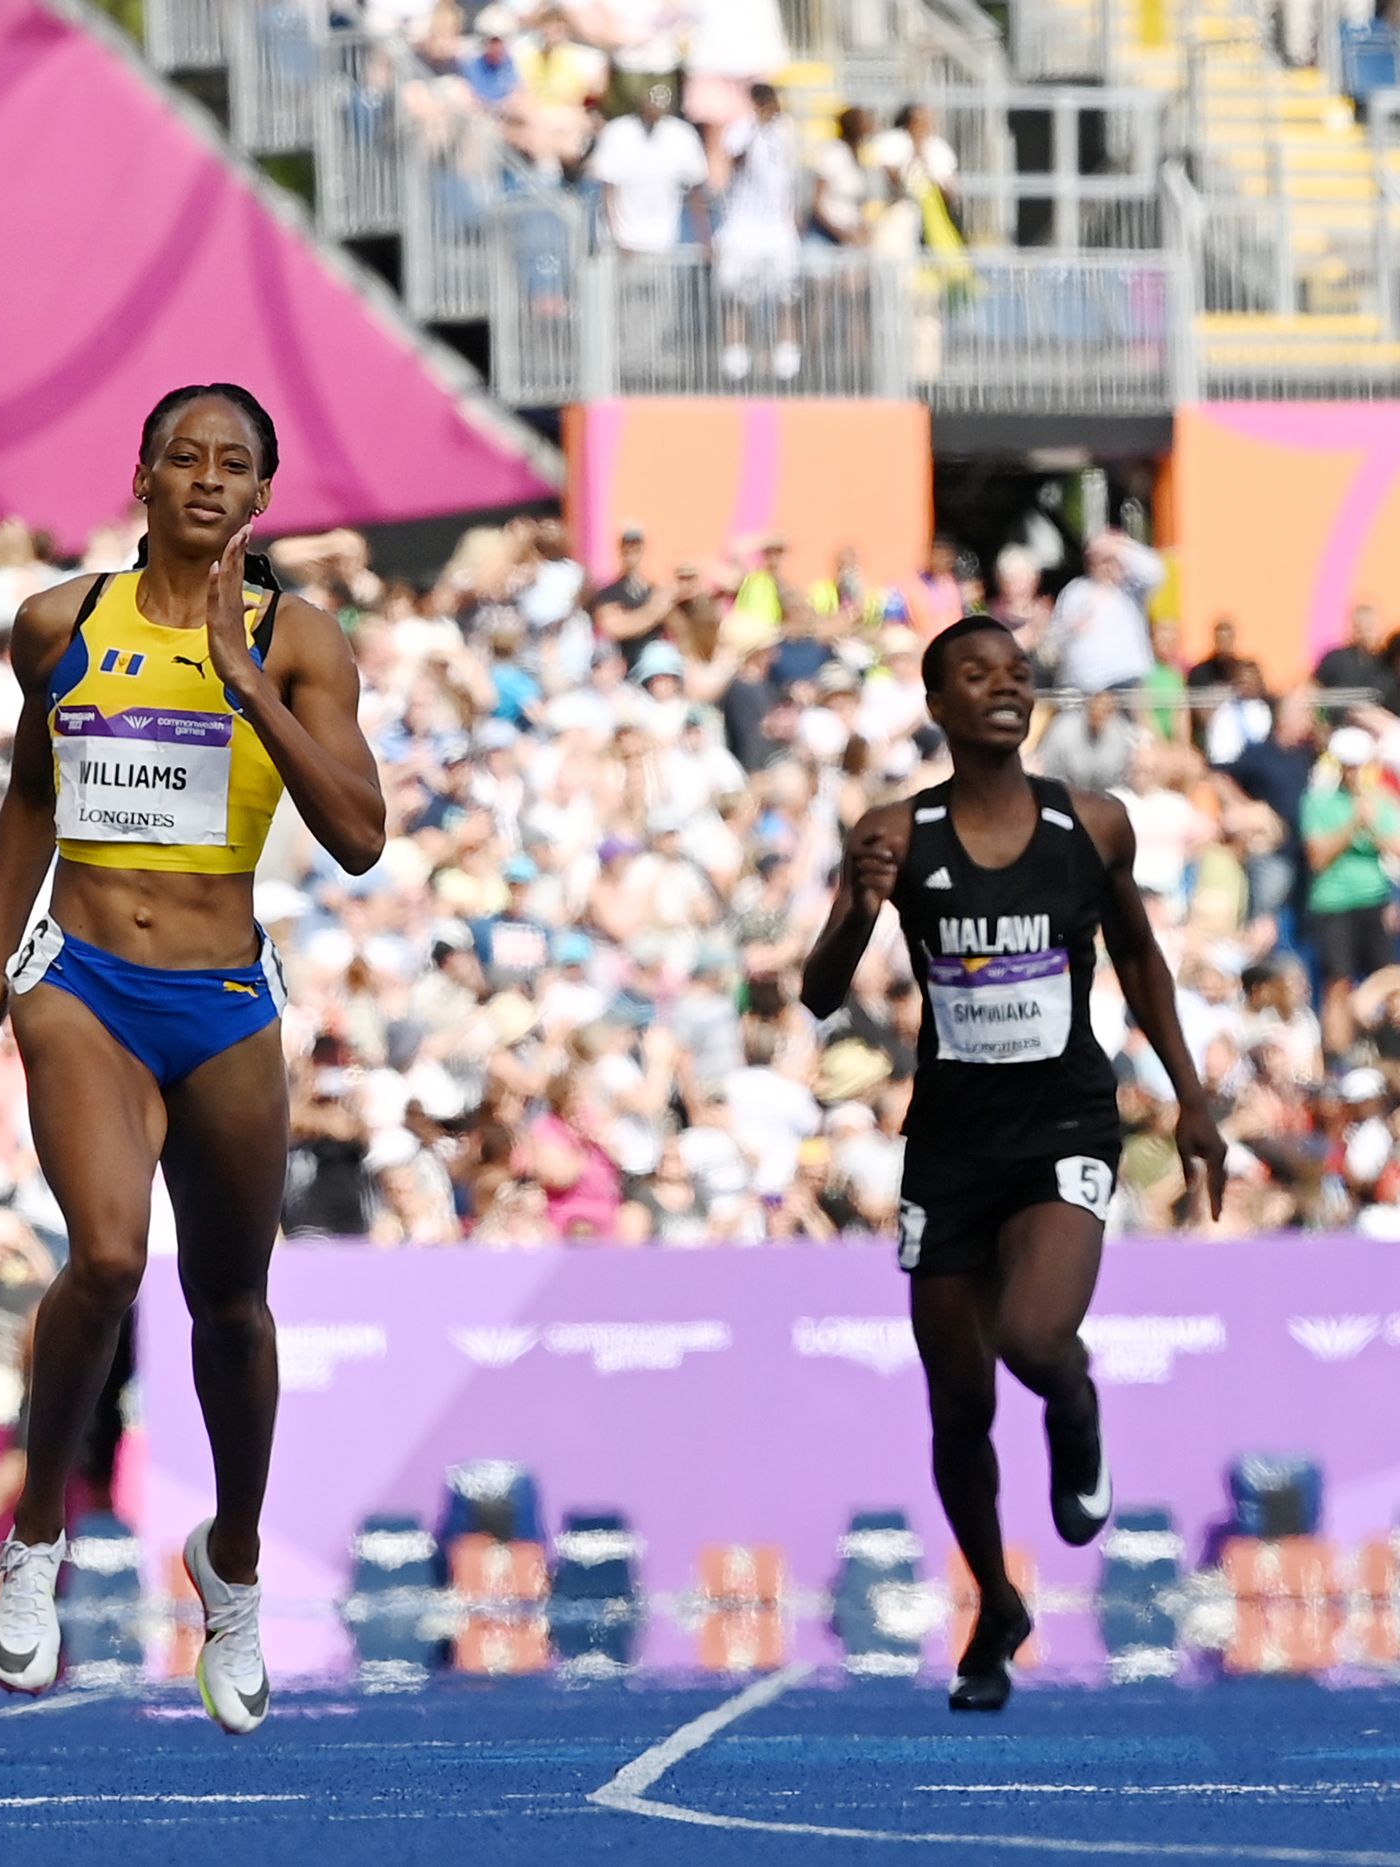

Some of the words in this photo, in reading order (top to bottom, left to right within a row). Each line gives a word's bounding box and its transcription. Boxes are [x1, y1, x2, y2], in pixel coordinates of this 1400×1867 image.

[79, 760, 188, 791] WILLIAMS
[79, 808, 176, 829] LONGINES
[938, 913, 1051, 955] MALAWI
[1080, 1163, 1100, 1205] 5
